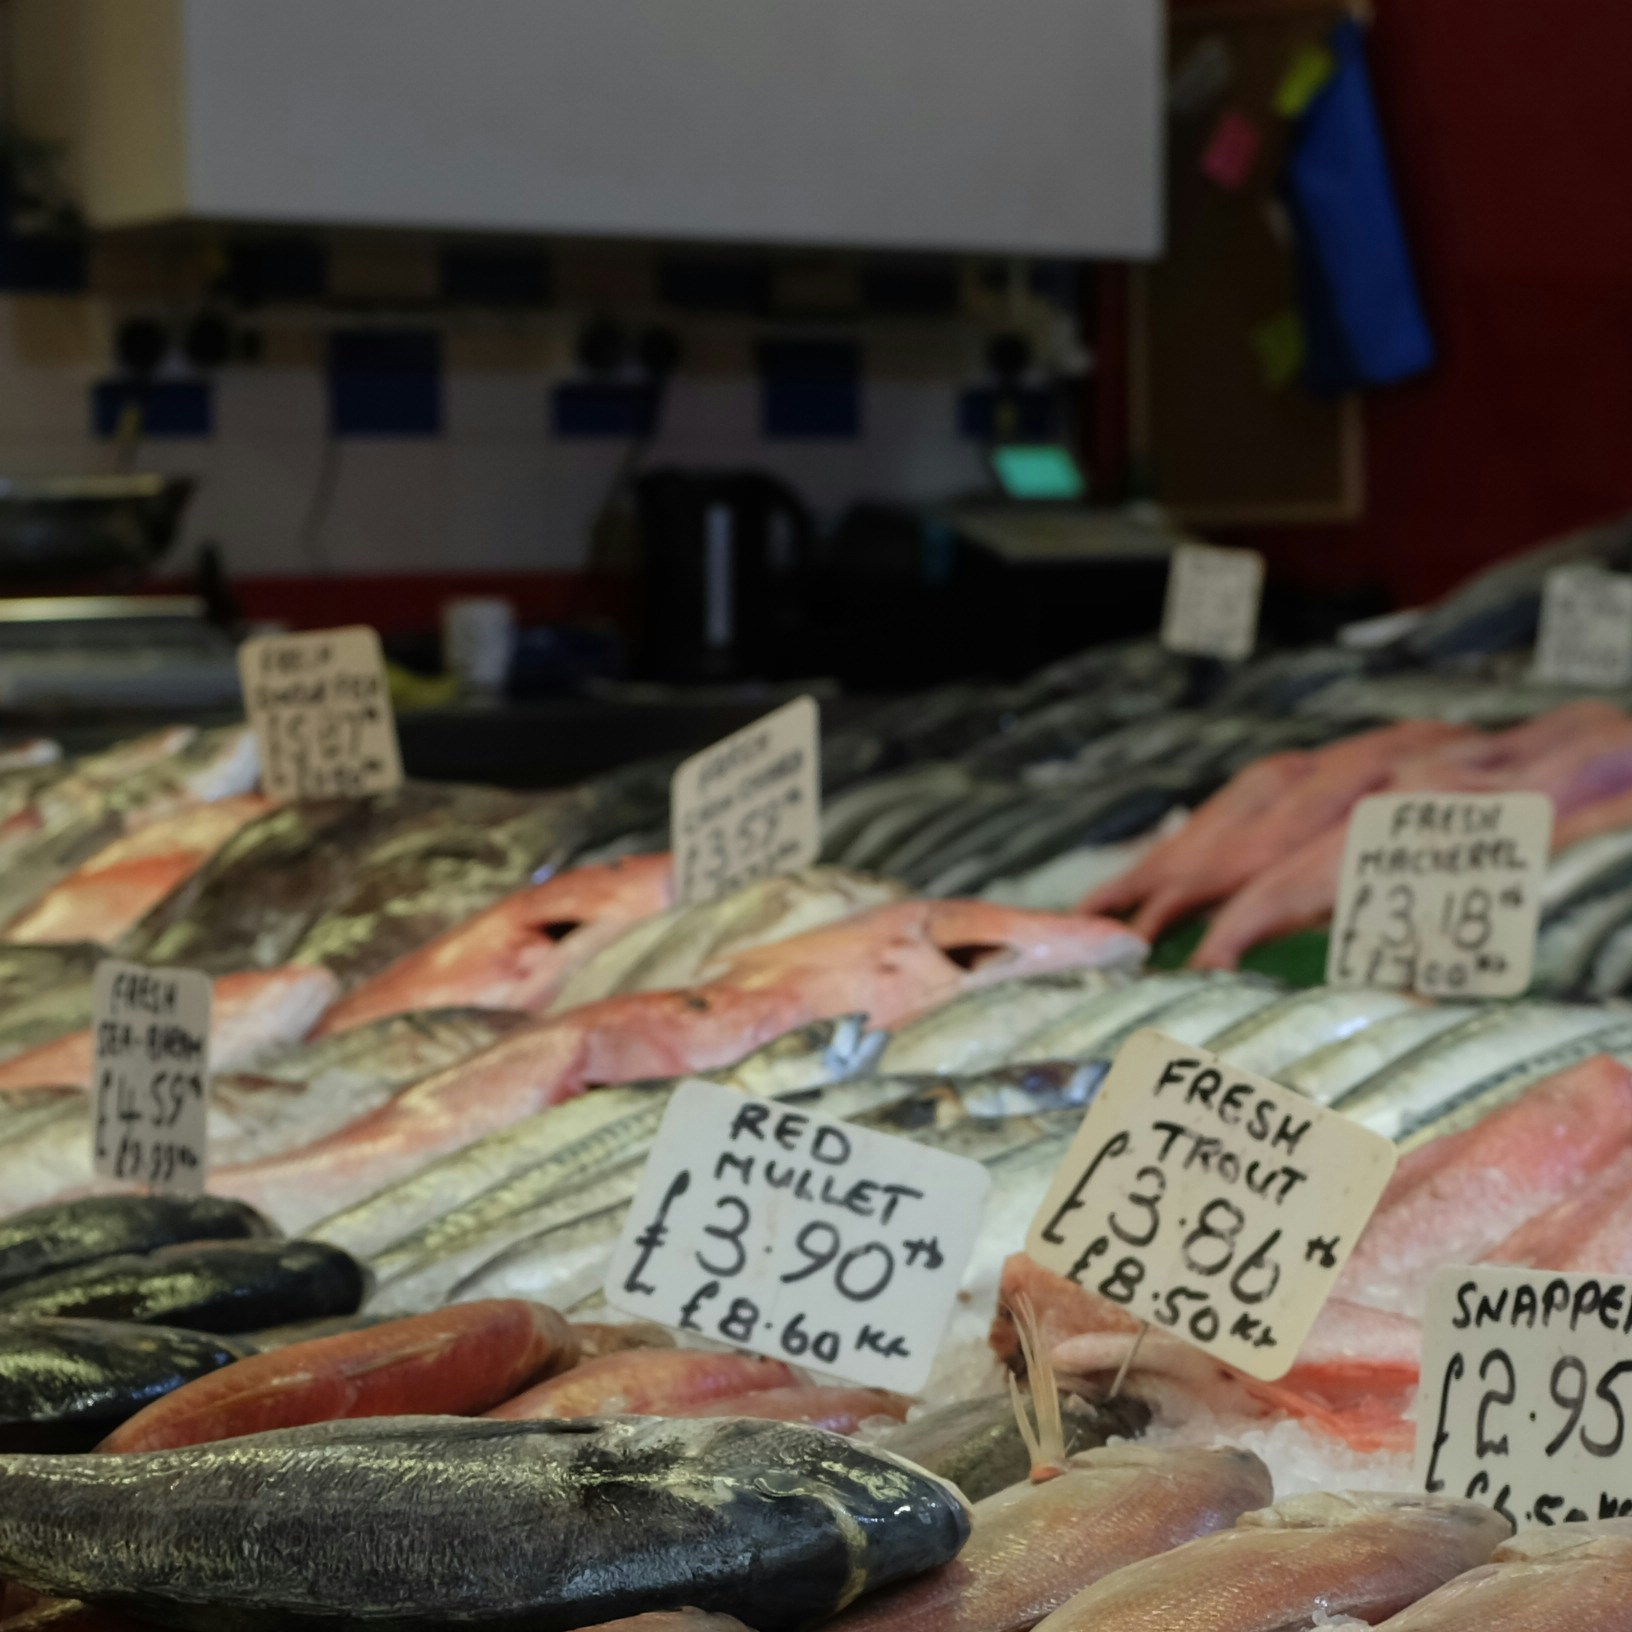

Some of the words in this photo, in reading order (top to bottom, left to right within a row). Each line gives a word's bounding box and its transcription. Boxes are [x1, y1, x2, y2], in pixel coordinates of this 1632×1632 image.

[1389, 802, 1504, 839] FRESH
[110, 971, 179, 1015] FRESH
[729, 1102, 853, 1167] RED
[1152, 1057, 1314, 1156] FRESH
[713, 1151, 926, 1226] MULLET
[1151, 1120, 1309, 1206] TROUT
[623, 1169, 896, 1303] £3.90
[1040, 1130, 1283, 1306] £3.86
[678, 1280, 842, 1364] £8.60
[1063, 1235, 1221, 1344] £8.50
